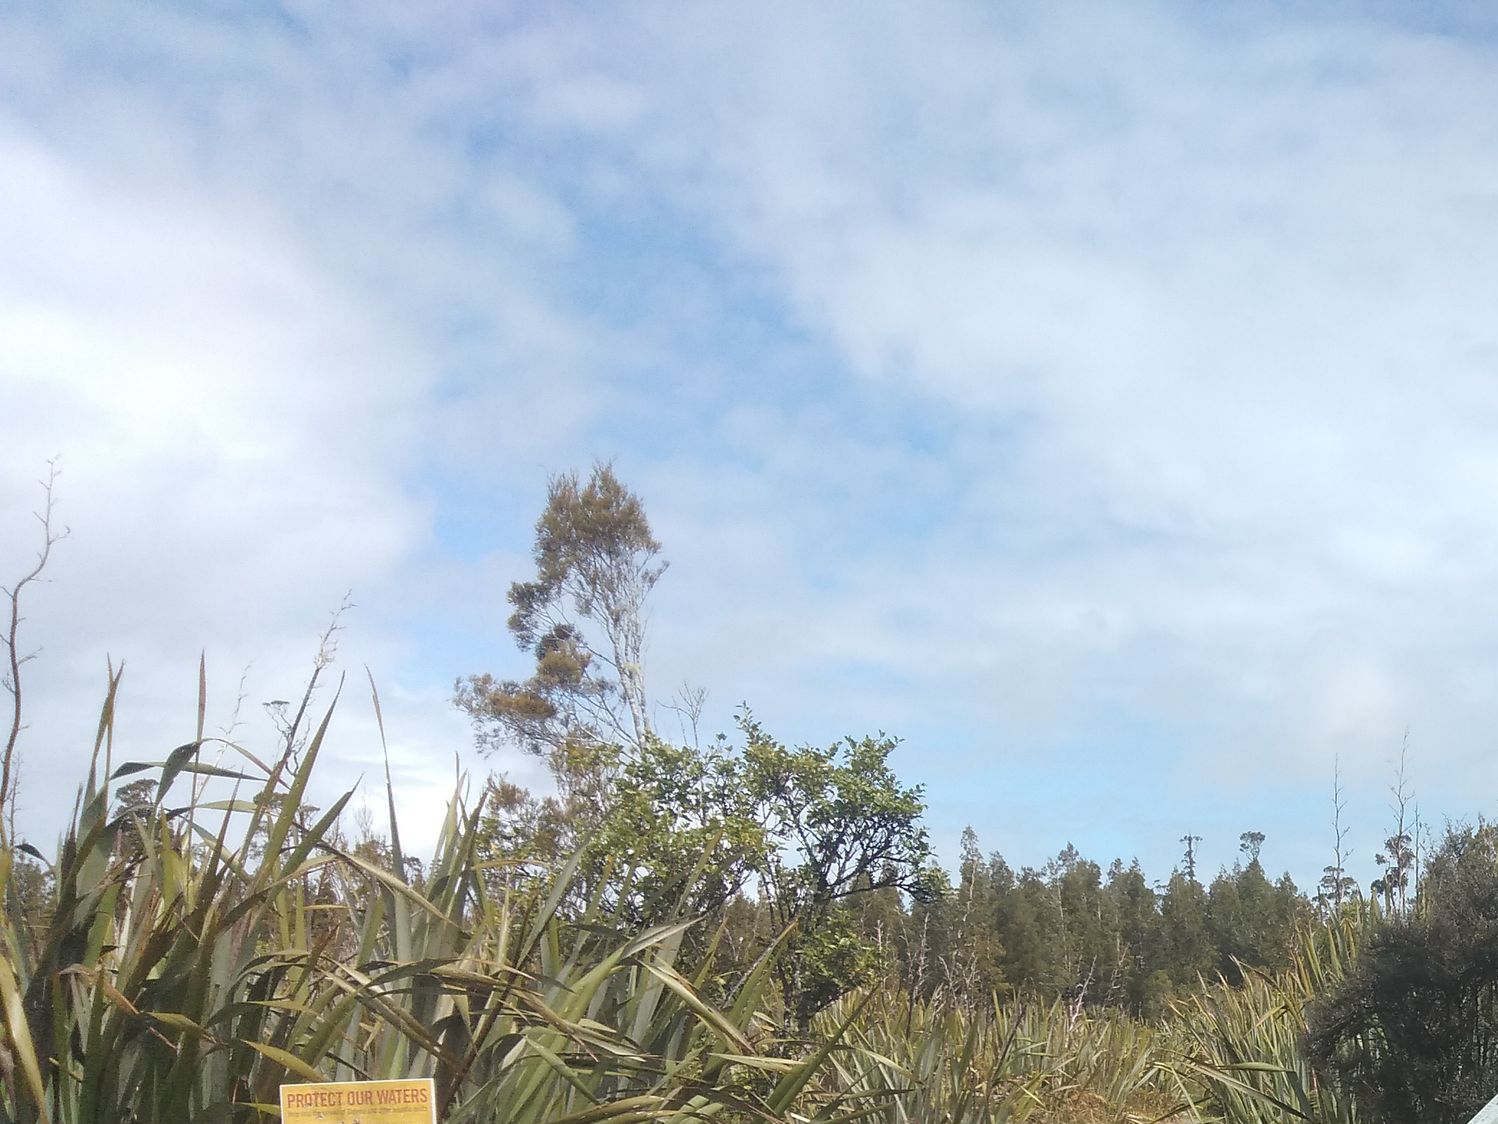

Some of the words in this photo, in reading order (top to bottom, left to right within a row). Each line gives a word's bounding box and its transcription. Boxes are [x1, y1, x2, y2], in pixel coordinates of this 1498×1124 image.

[287, 1092, 343, 1108] PROTECT
[347, 1090, 374, 1106] OUR
[377, 1088, 428, 1104] WATERS
